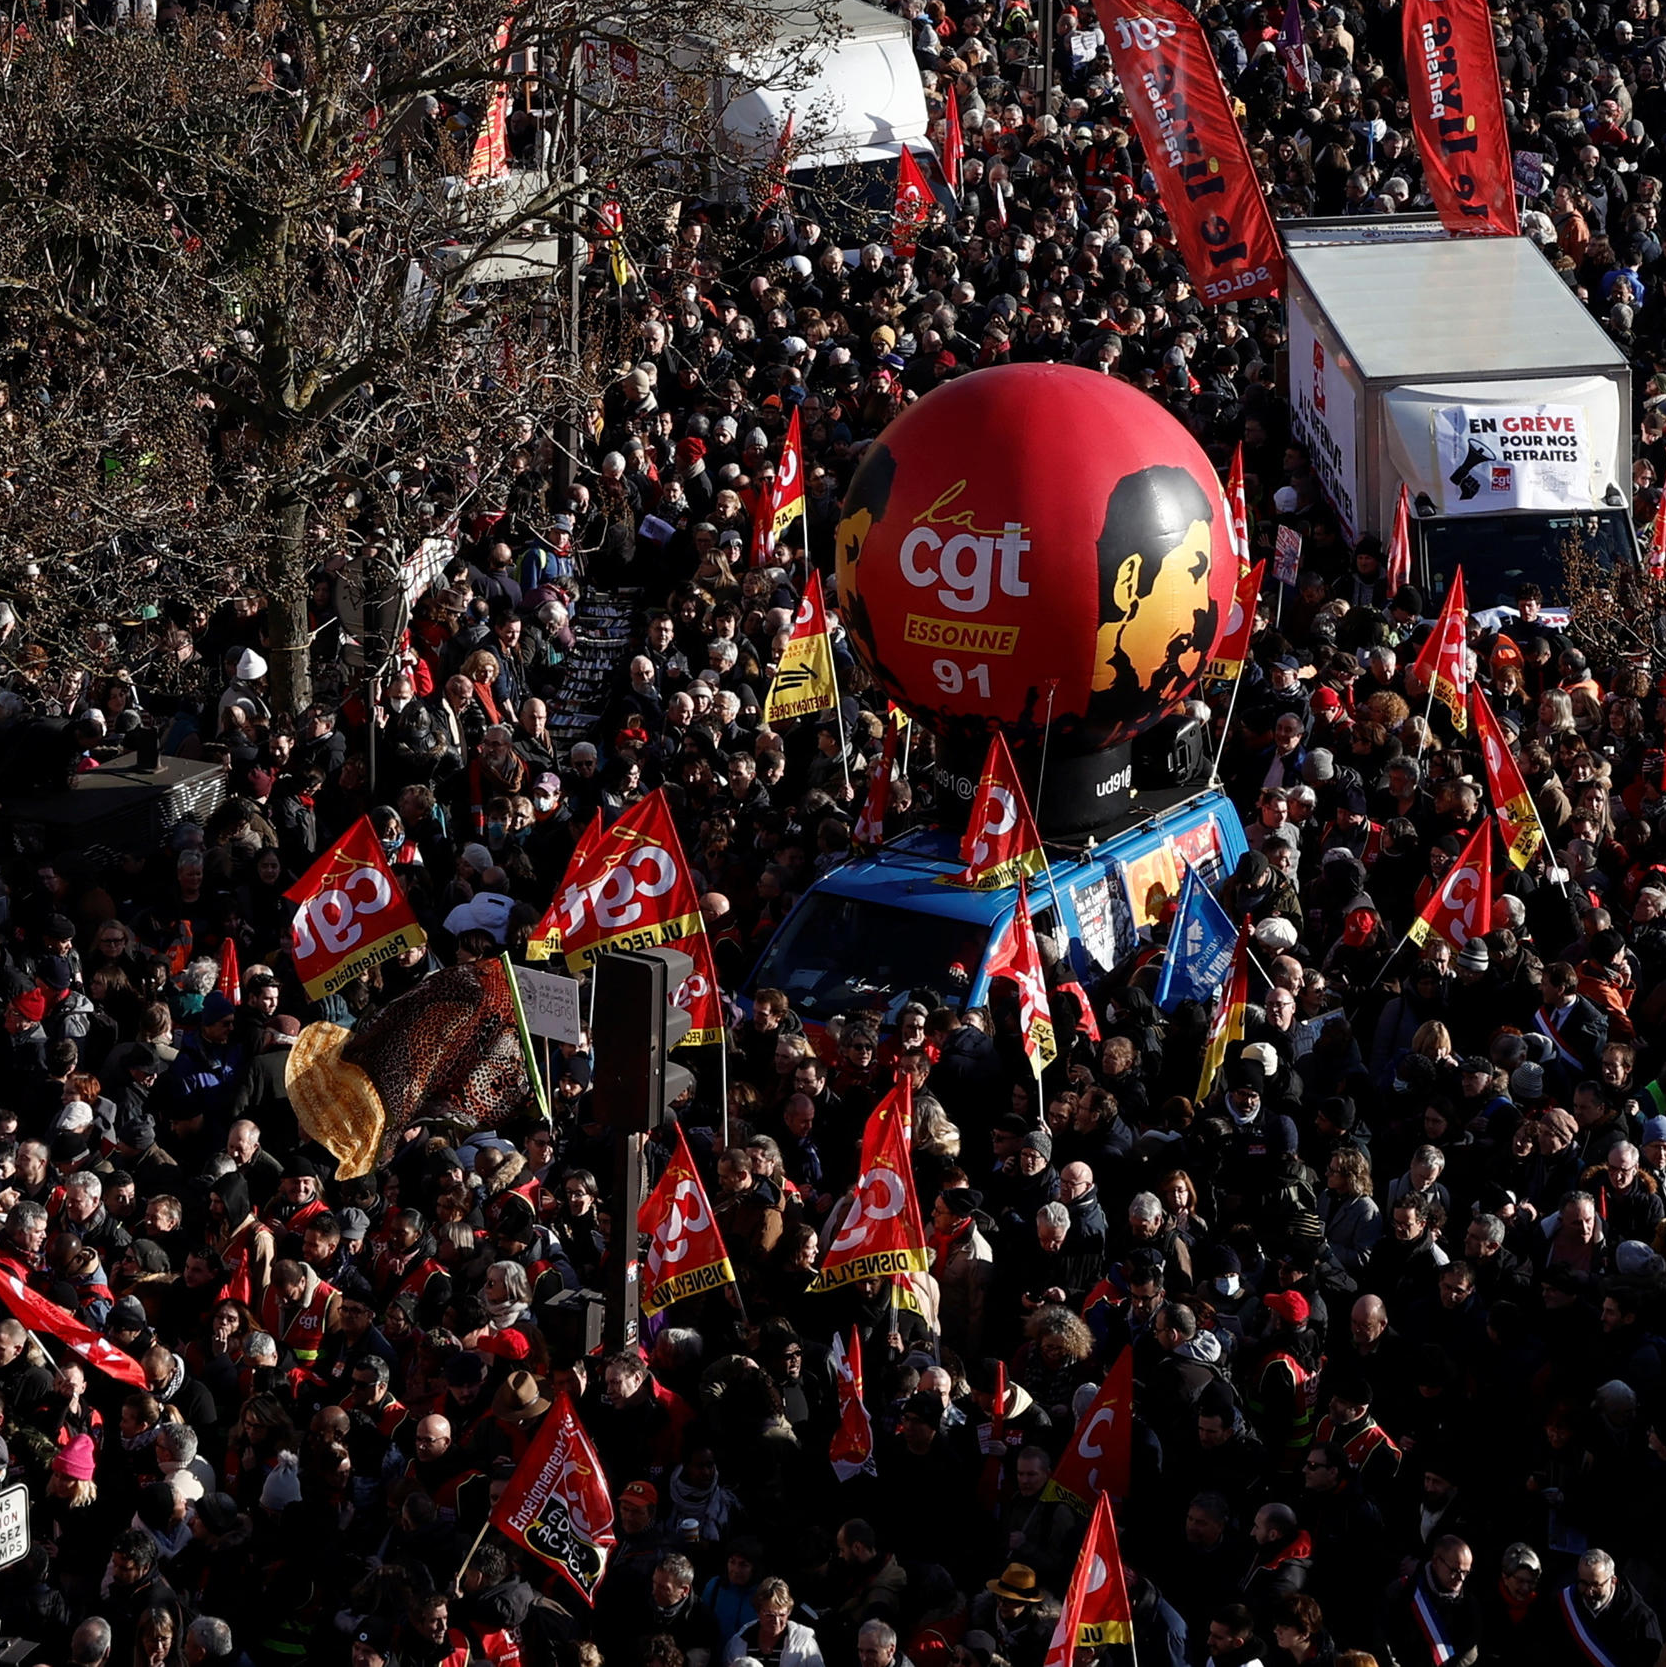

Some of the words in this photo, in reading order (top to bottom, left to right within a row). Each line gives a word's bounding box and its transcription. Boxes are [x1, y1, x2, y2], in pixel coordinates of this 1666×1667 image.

[1469, 418, 1497, 433] EN
[1502, 416, 1575, 433] GRÈVE
[1500, 435, 1543, 448] POUR
[1546, 435, 1577, 448] NOS
[1503, 449, 1578, 462] RETRAITES
[1491, 475, 1511, 487] cgt
[912, 478, 1030, 534] la
[899, 522, 1031, 613] cgt
[908, 620, 1014, 651] ESSONNE
[933, 659, 992, 699] 91
[298, 1315, 318, 1330] cgt
